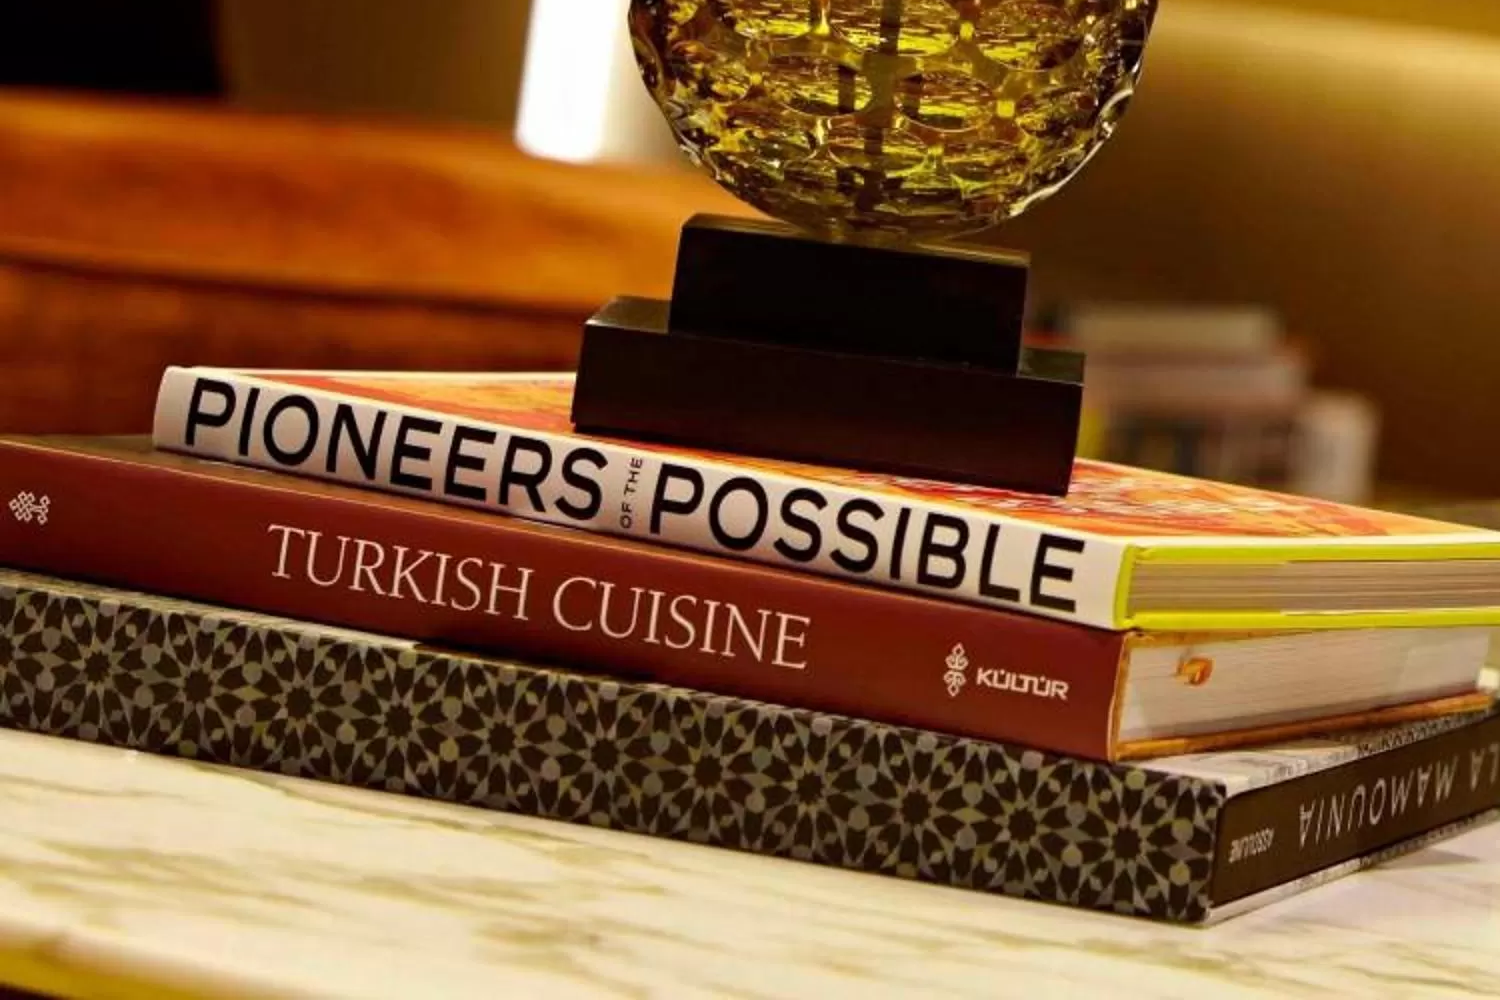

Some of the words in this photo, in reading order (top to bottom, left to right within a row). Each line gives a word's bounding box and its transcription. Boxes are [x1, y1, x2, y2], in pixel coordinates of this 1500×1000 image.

[183, 376, 609, 521] PIONEERS
[623, 457, 643, 497] THE
[619, 502, 632, 529] OF
[649, 462, 1086, 613] POSSIBLE
[266, 523, 535, 621] TURKISH
[552, 575, 812, 670] CUISINE
[975, 667, 1069, 700] KÜLTÜR
[1299, 755, 1457, 848] MAMOUNIA
[1470, 742, 1500, 792] LA
